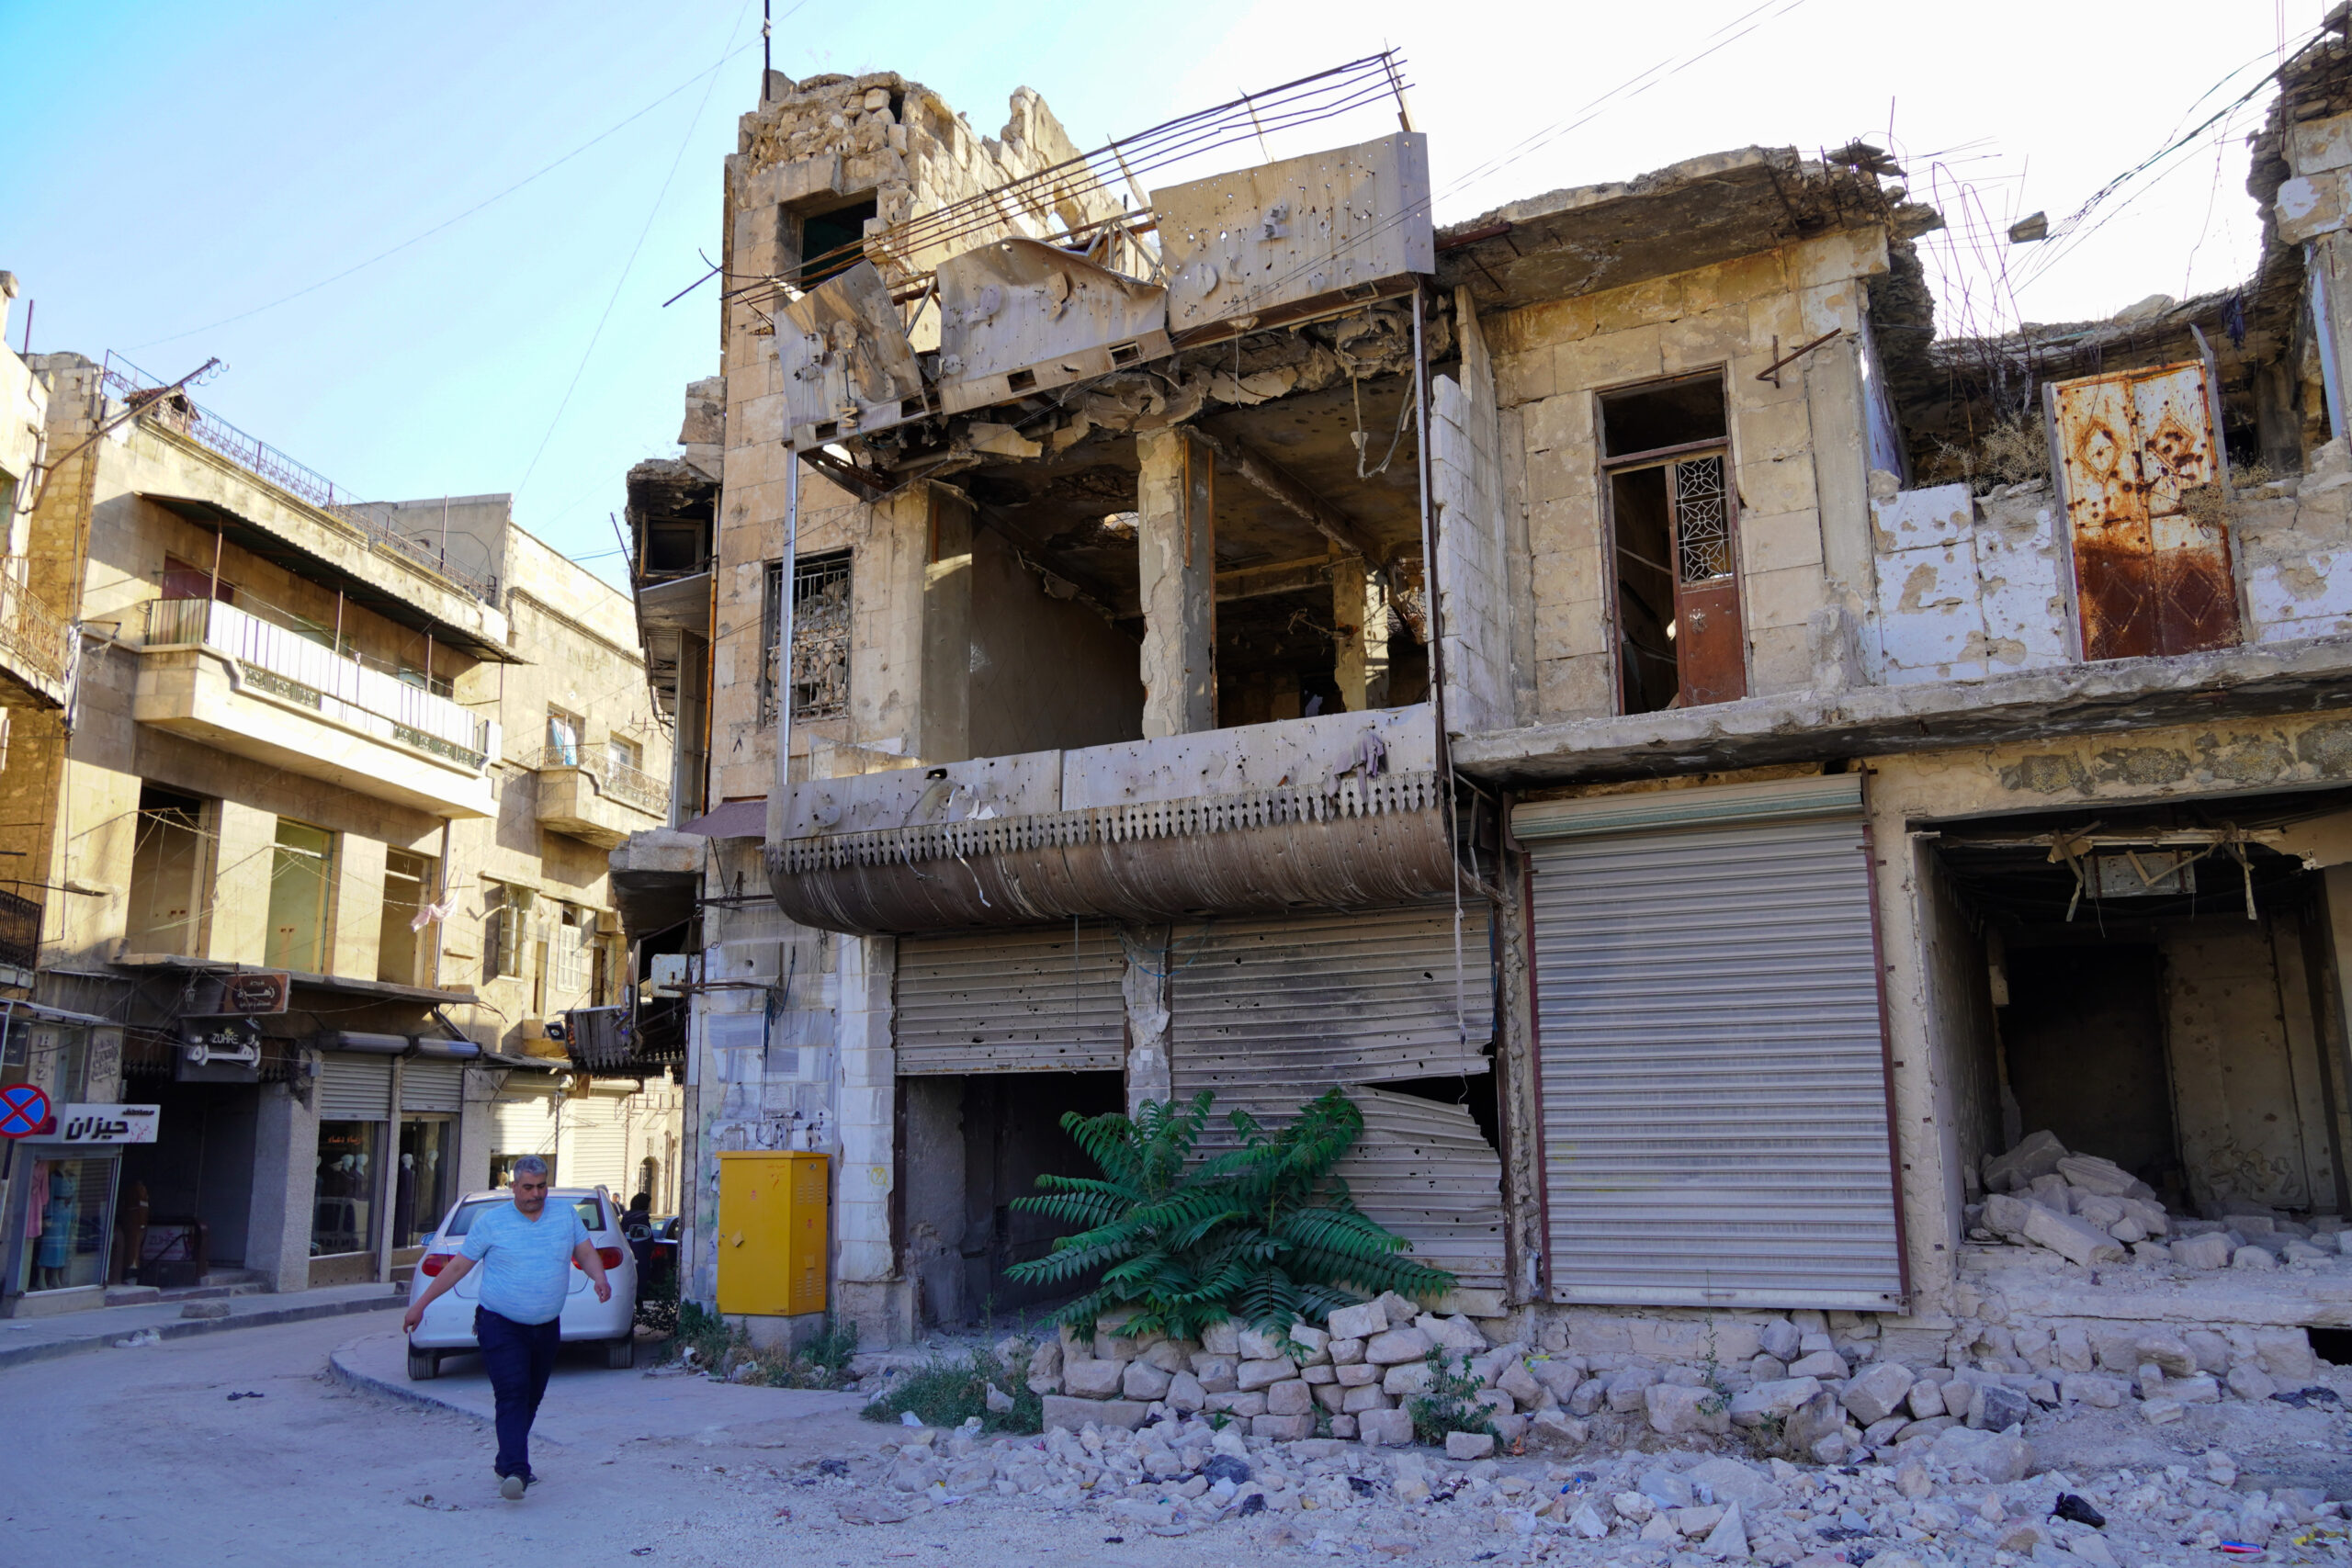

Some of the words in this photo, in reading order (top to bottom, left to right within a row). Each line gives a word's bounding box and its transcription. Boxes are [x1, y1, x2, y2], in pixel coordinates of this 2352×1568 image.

[187, 1033, 261, 1067] زهرة
[211, 1032, 239, 1044] ZUHRE
[65, 1116, 129, 1140] حيزان
